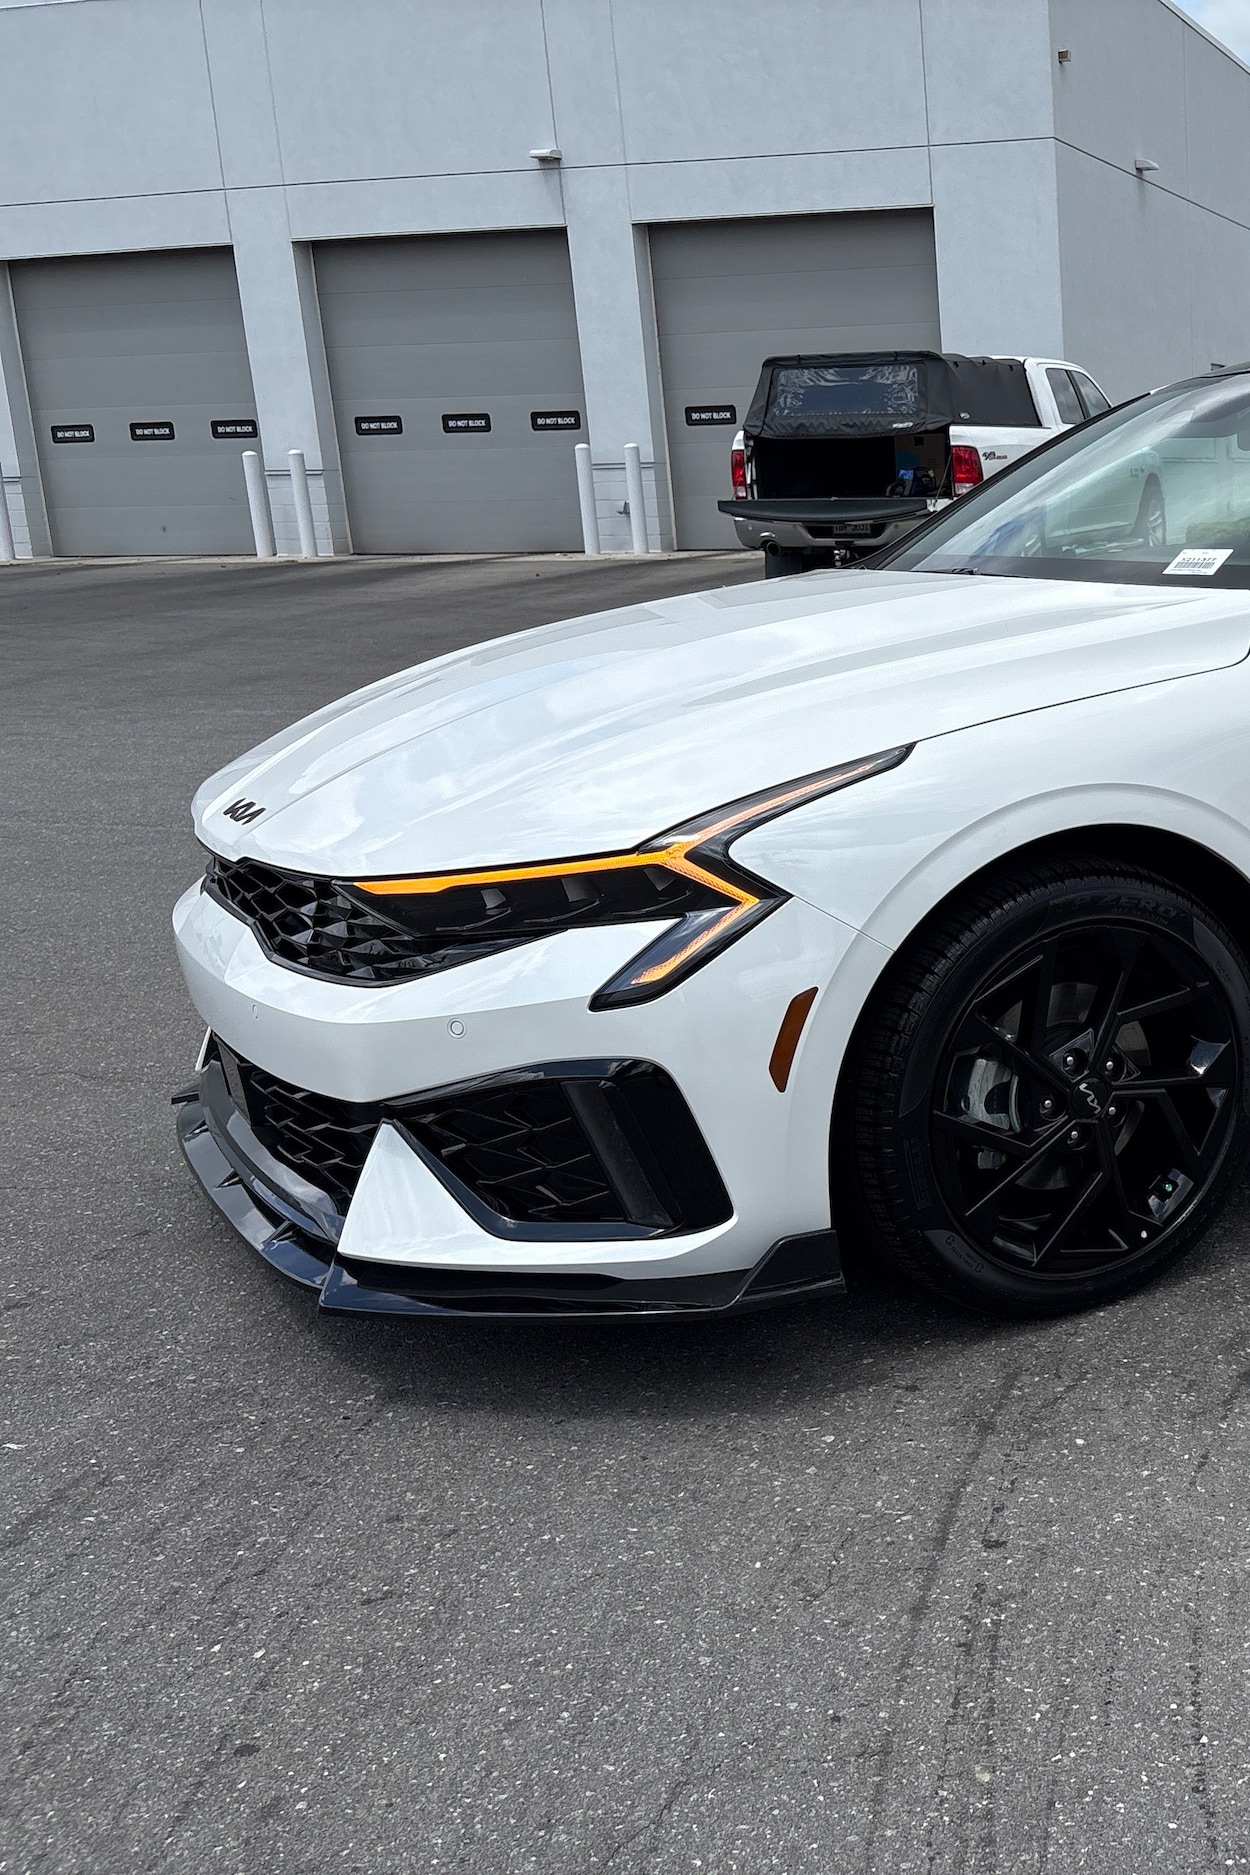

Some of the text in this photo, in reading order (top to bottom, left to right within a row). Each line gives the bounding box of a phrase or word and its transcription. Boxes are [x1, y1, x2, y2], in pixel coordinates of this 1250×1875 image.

[691, 411, 731, 420] DO NOT BLOCK
[381, 421, 398, 429] BLOCK
[469, 419, 486, 427] BLOCK
[537, 417, 545, 425] DO
[546, 417, 557, 425] NOT
[154, 427, 170, 435] BLOCK
[226, 425, 236, 433] NOT
[236, 425, 253, 433] BLOCK
[223, 797, 267, 826] KIA
